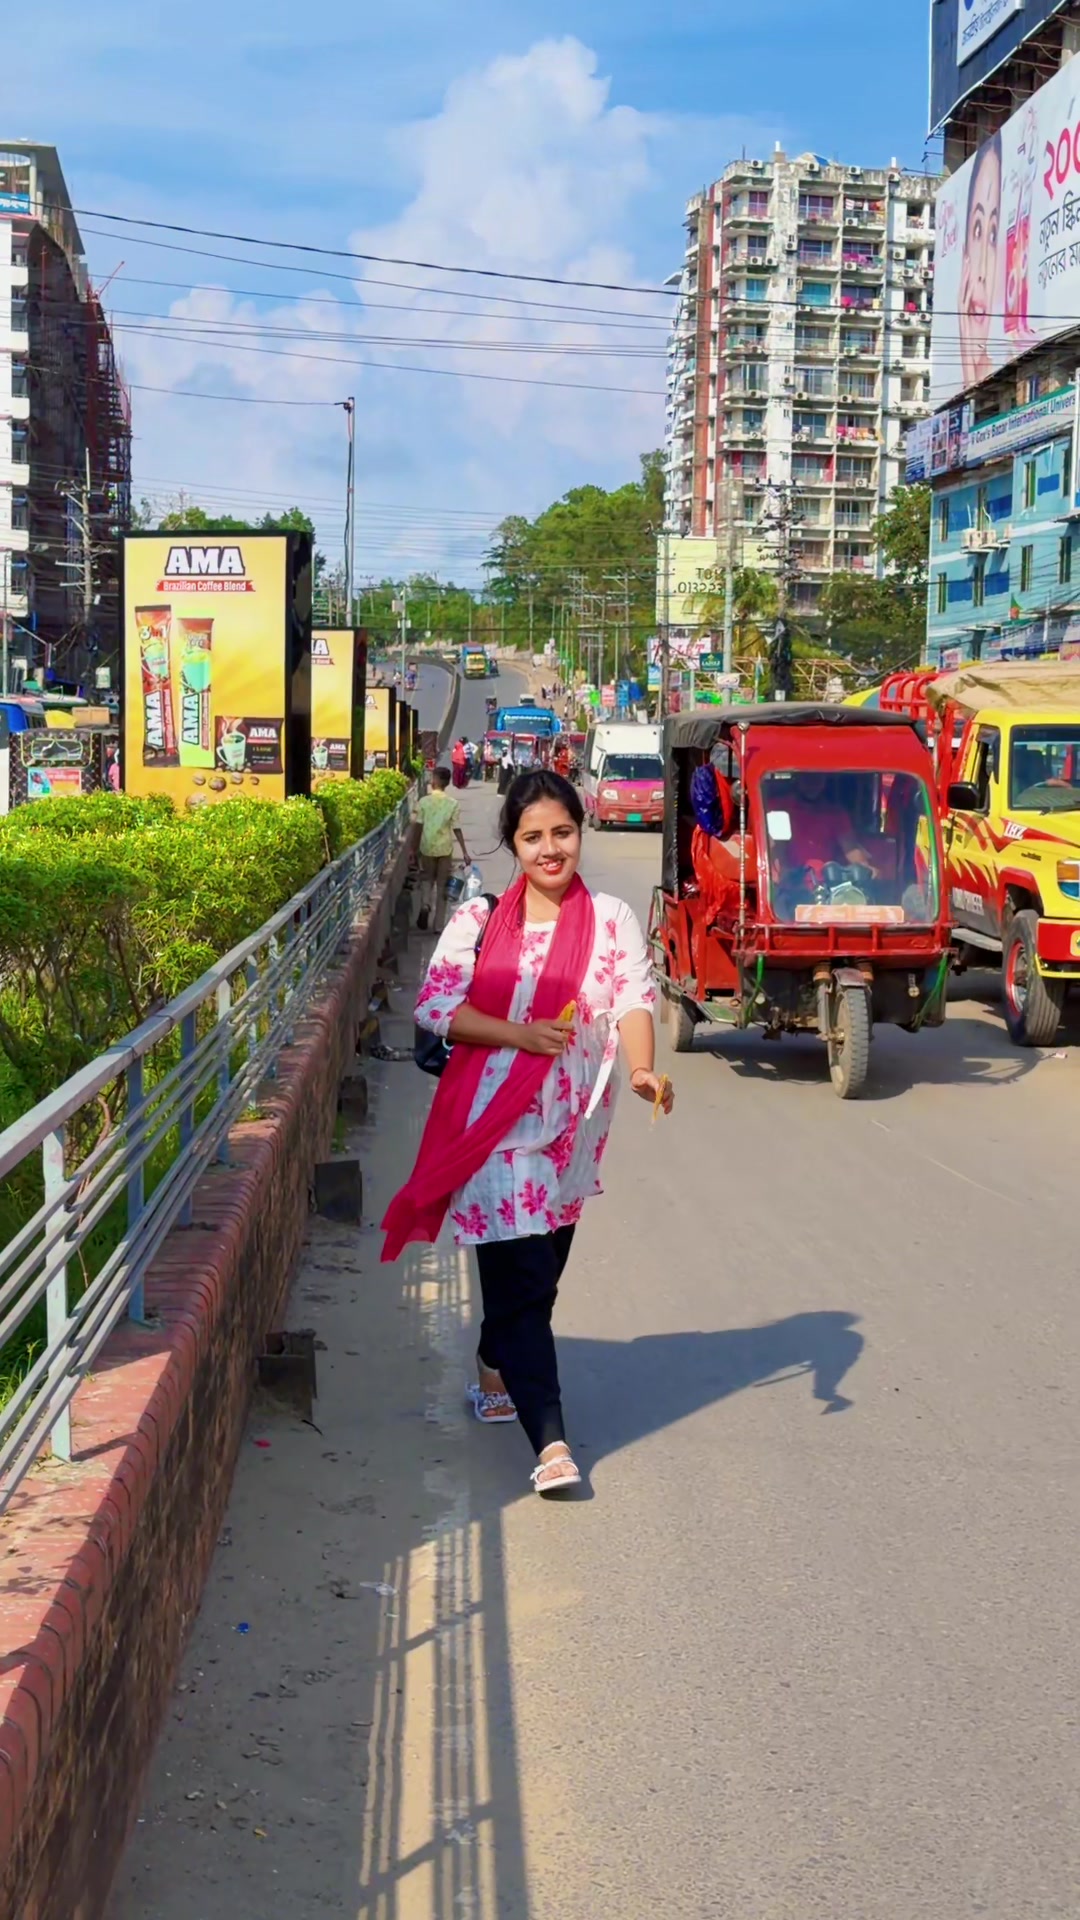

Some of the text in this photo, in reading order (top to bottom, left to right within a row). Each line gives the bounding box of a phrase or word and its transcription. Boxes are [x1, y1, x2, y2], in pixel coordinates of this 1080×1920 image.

[1039, 209, 1060, 253] নতুন
[991, 420, 1008, 438] Bazar
[1008, 404, 1049, 430] International
[165, 546, 245, 576] AMA
[163, 581, 247, 592] Brazilian Coffee Blend
[145, 690, 164, 748] AMA
[182, 693, 200, 745] AMA
[249, 726, 278, 738] AMA
